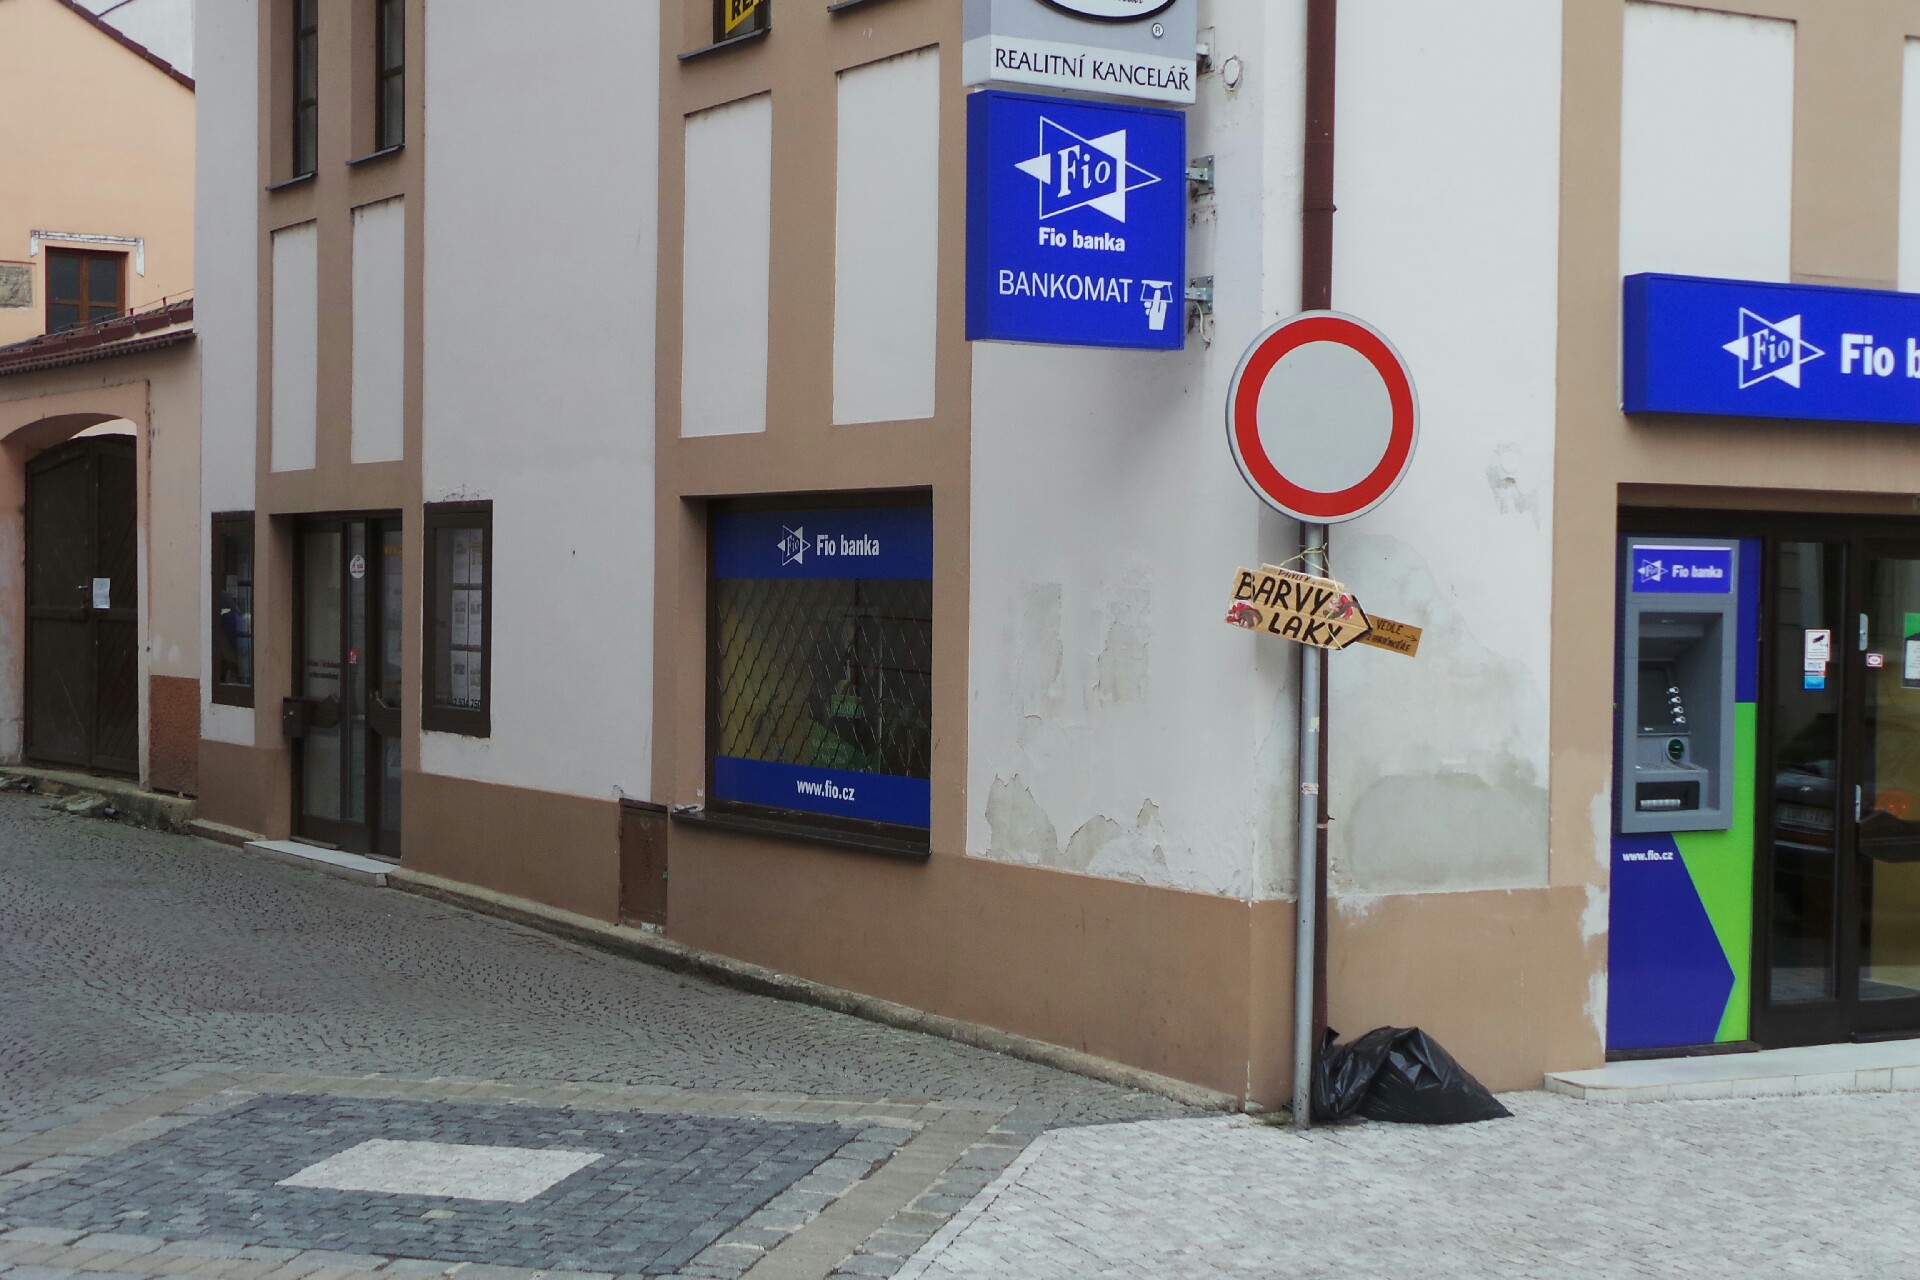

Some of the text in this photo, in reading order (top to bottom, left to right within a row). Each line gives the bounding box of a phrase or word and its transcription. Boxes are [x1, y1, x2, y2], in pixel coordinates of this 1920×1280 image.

[995, 48, 1190, 91] REALITNÍ KANCELÁŘ
[1057, 144, 1111, 198] Fio
[1038, 227, 1126, 252] Fio banka
[999, 269, 1133, 303] BANKOMAT
[1751, 328, 1790, 371] Fio
[1840, 333, 1895, 377] Fio
[786, 534, 800, 557] Fio
[816, 533, 880, 556] Fio banka
[1672, 564, 1723, 578] Fio banka
[1234, 572, 1334, 616] BARVY
[1268, 612, 1343, 646] LAKY
[1376, 619, 1404, 635] VEDLE
[796, 779, 855, 801] www.fio.cz
[1622, 849, 1674, 861] www.fio.cz
